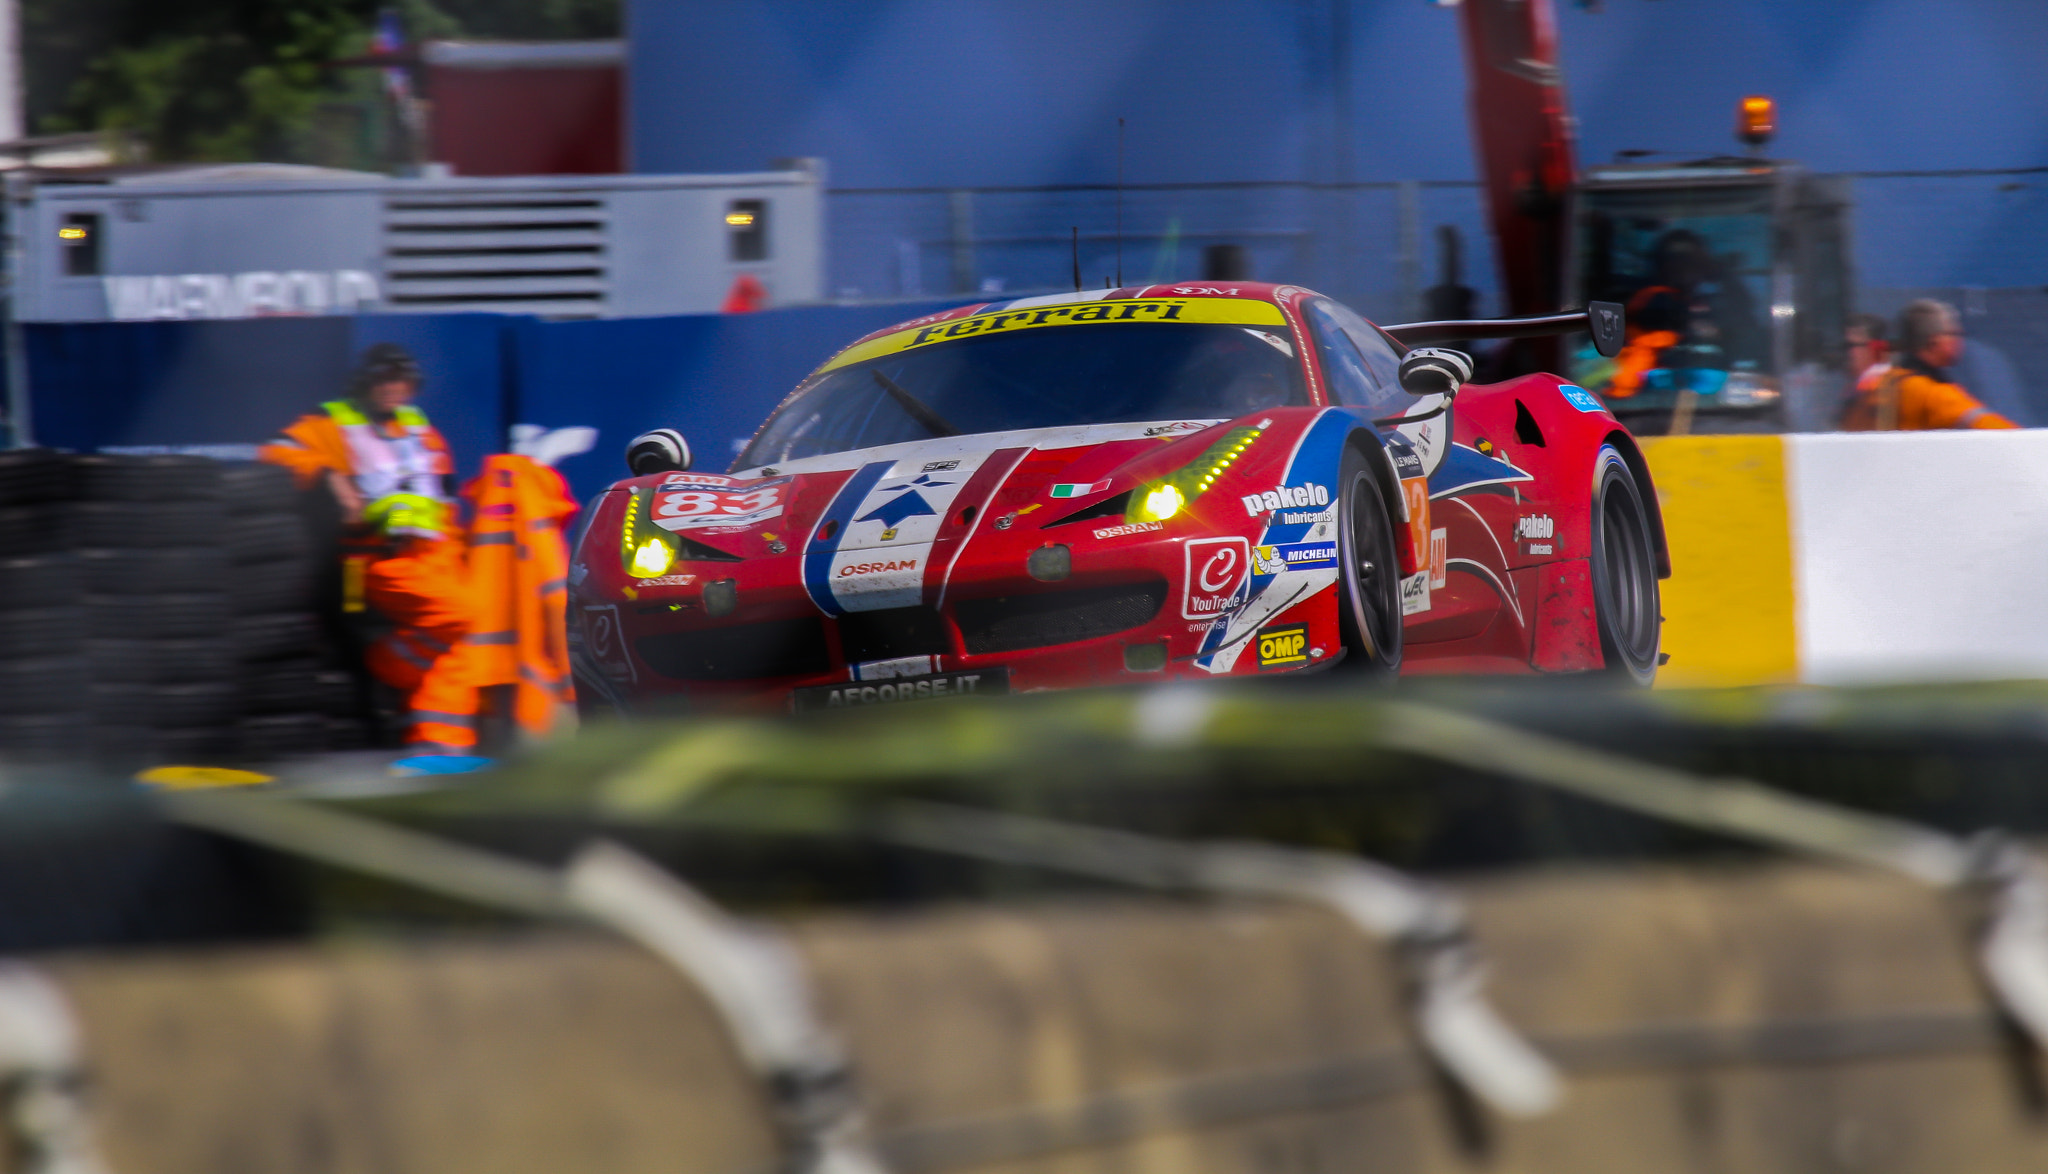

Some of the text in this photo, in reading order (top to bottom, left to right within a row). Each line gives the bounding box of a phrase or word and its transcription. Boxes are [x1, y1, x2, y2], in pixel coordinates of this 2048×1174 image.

[903, 300, 1187, 350] Ferrari
[658, 488, 781, 516] 83
[1240, 481, 1330, 518] pakelo
[1284, 510, 1333, 525] lubricants
[1519, 512, 1555, 539] pakelo
[1096, 521, 1163, 539] OSRAM
[1287, 548, 1337, 562] MICHELIN
[840, 559, 917, 577] OSRAM
[1192, 595, 1241, 612] YouTrade
[1260, 635, 1306, 659] OMP
